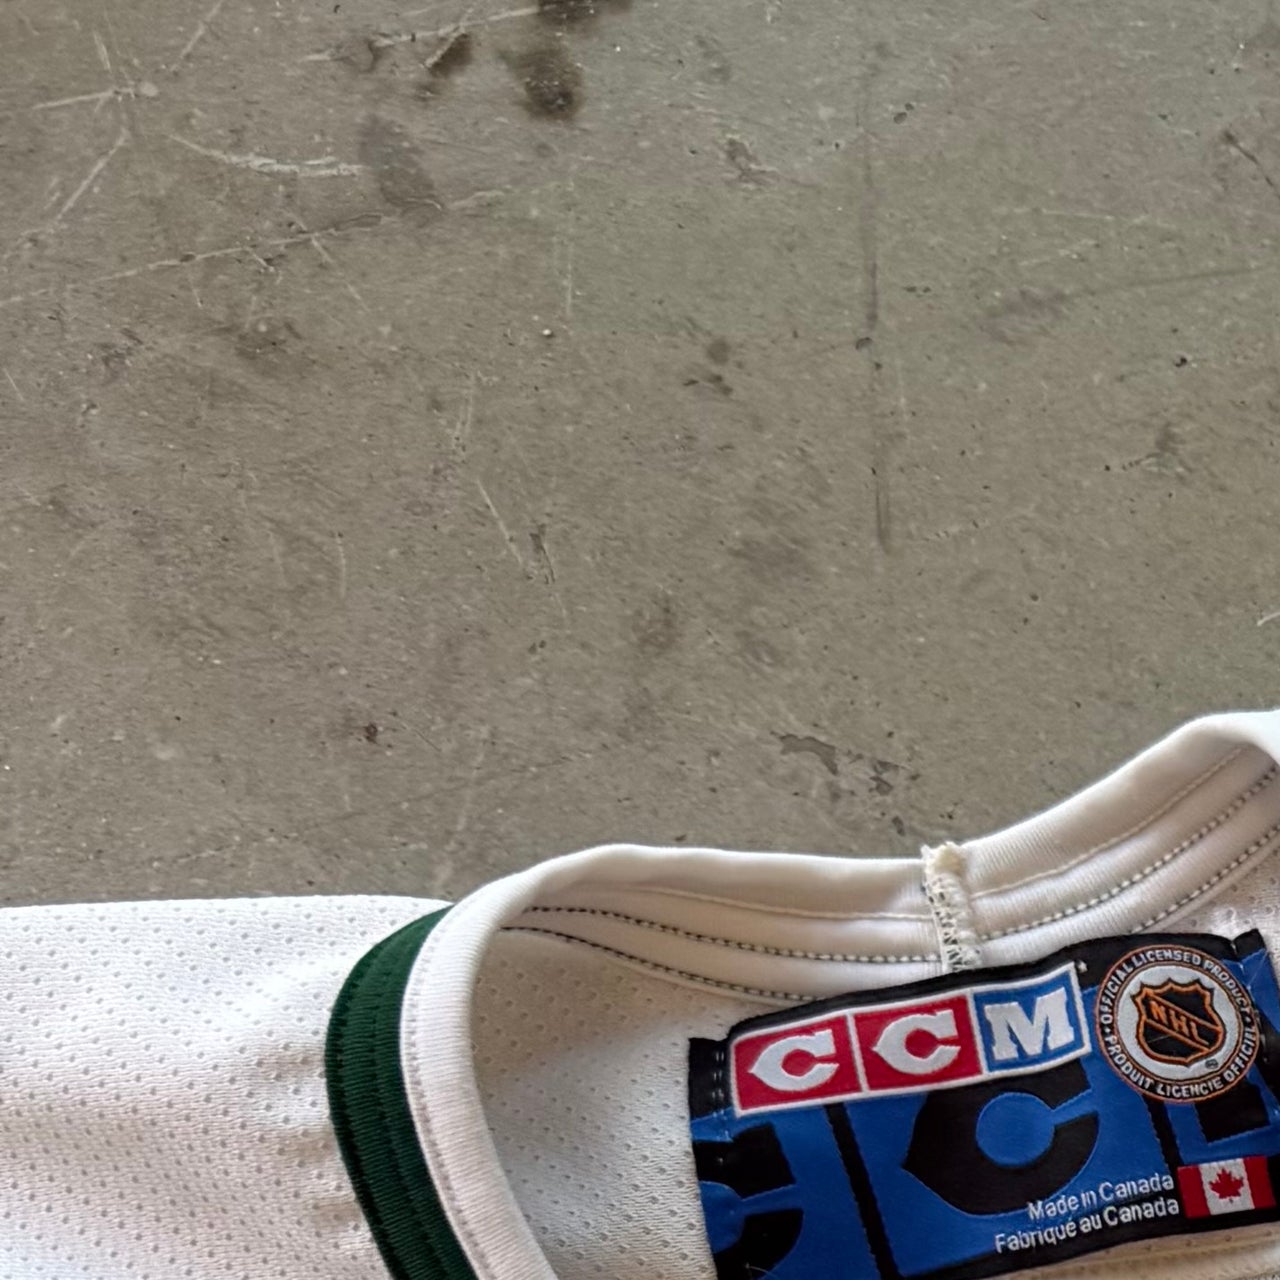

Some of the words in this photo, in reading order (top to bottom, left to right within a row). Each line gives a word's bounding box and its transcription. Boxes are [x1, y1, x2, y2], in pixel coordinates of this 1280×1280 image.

[1100, 962, 1133, 1024] OFFICIAL
[1132, 949, 1201, 967] LICENSED
[1203, 959, 1250, 1013] PRODUCT
[748, 986, 1075, 1091] CCM
[1150, 1000, 1210, 1045] NHL
[1105, 1035, 1155, 1089] PRODUIT
[1027, 1194, 1080, 1221] Made
[1081, 1190, 1097, 1208] in
[1099, 1172, 1175, 1200] Canada
[1079, 1213, 1102, 1233] au
[1103, 1197, 1180, 1226] Canada
